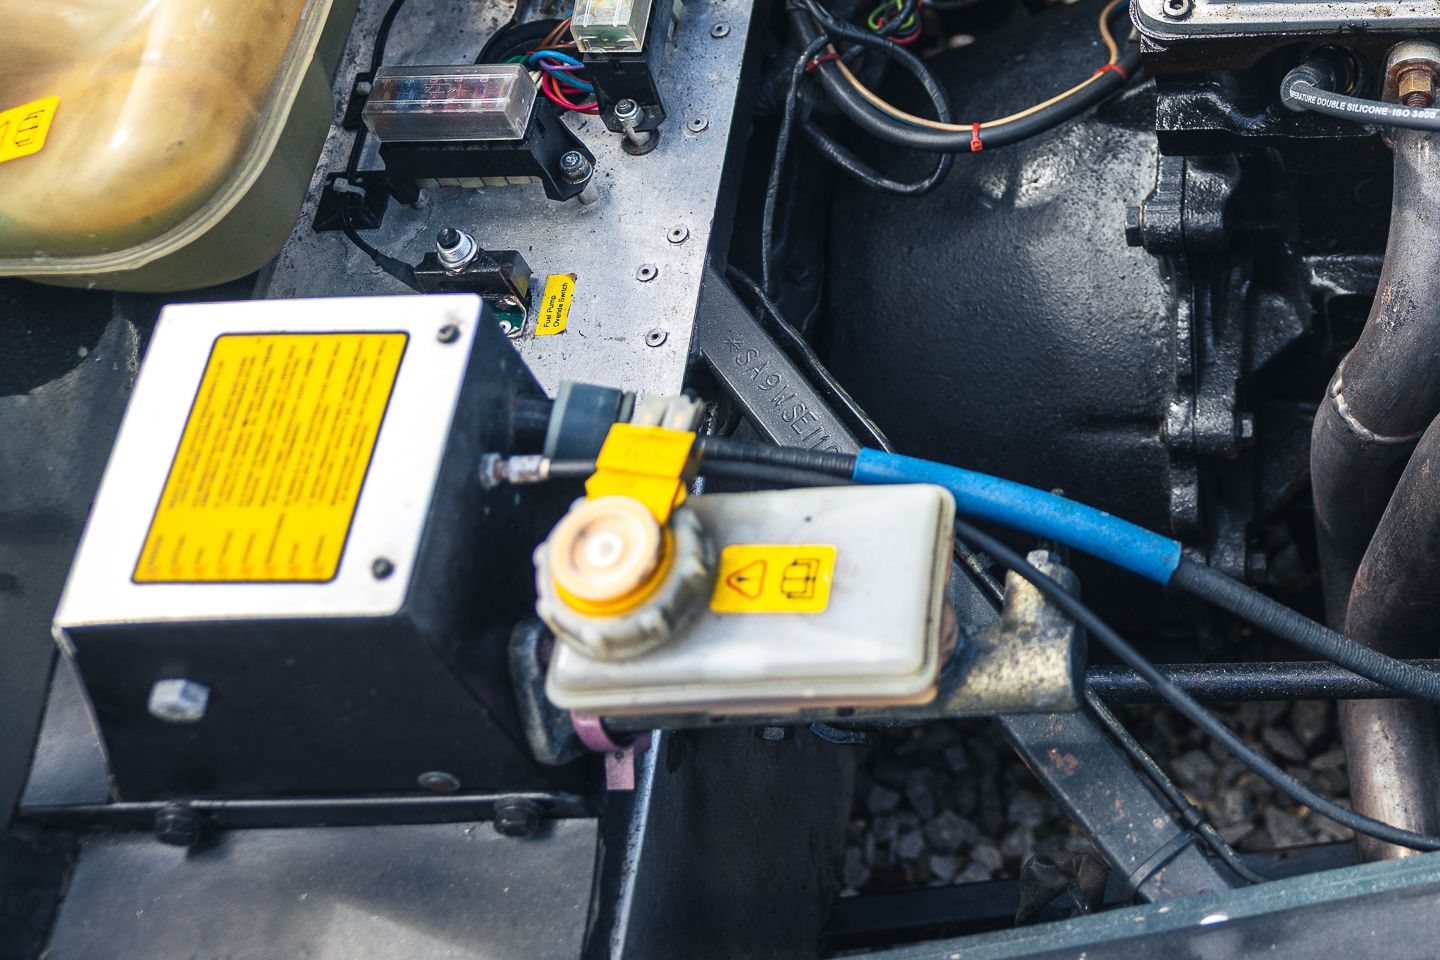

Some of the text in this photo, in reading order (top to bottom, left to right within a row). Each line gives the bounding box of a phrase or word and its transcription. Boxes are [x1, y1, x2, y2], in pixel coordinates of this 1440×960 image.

[1316, 97, 1346, 111] DOUBLE
[1347, 102, 1389, 117] SILICONE
[1392, 109, 1411, 118] ISO
[558, 282, 569, 303] Switch
[543, 294, 557, 328] Fuel Pump
